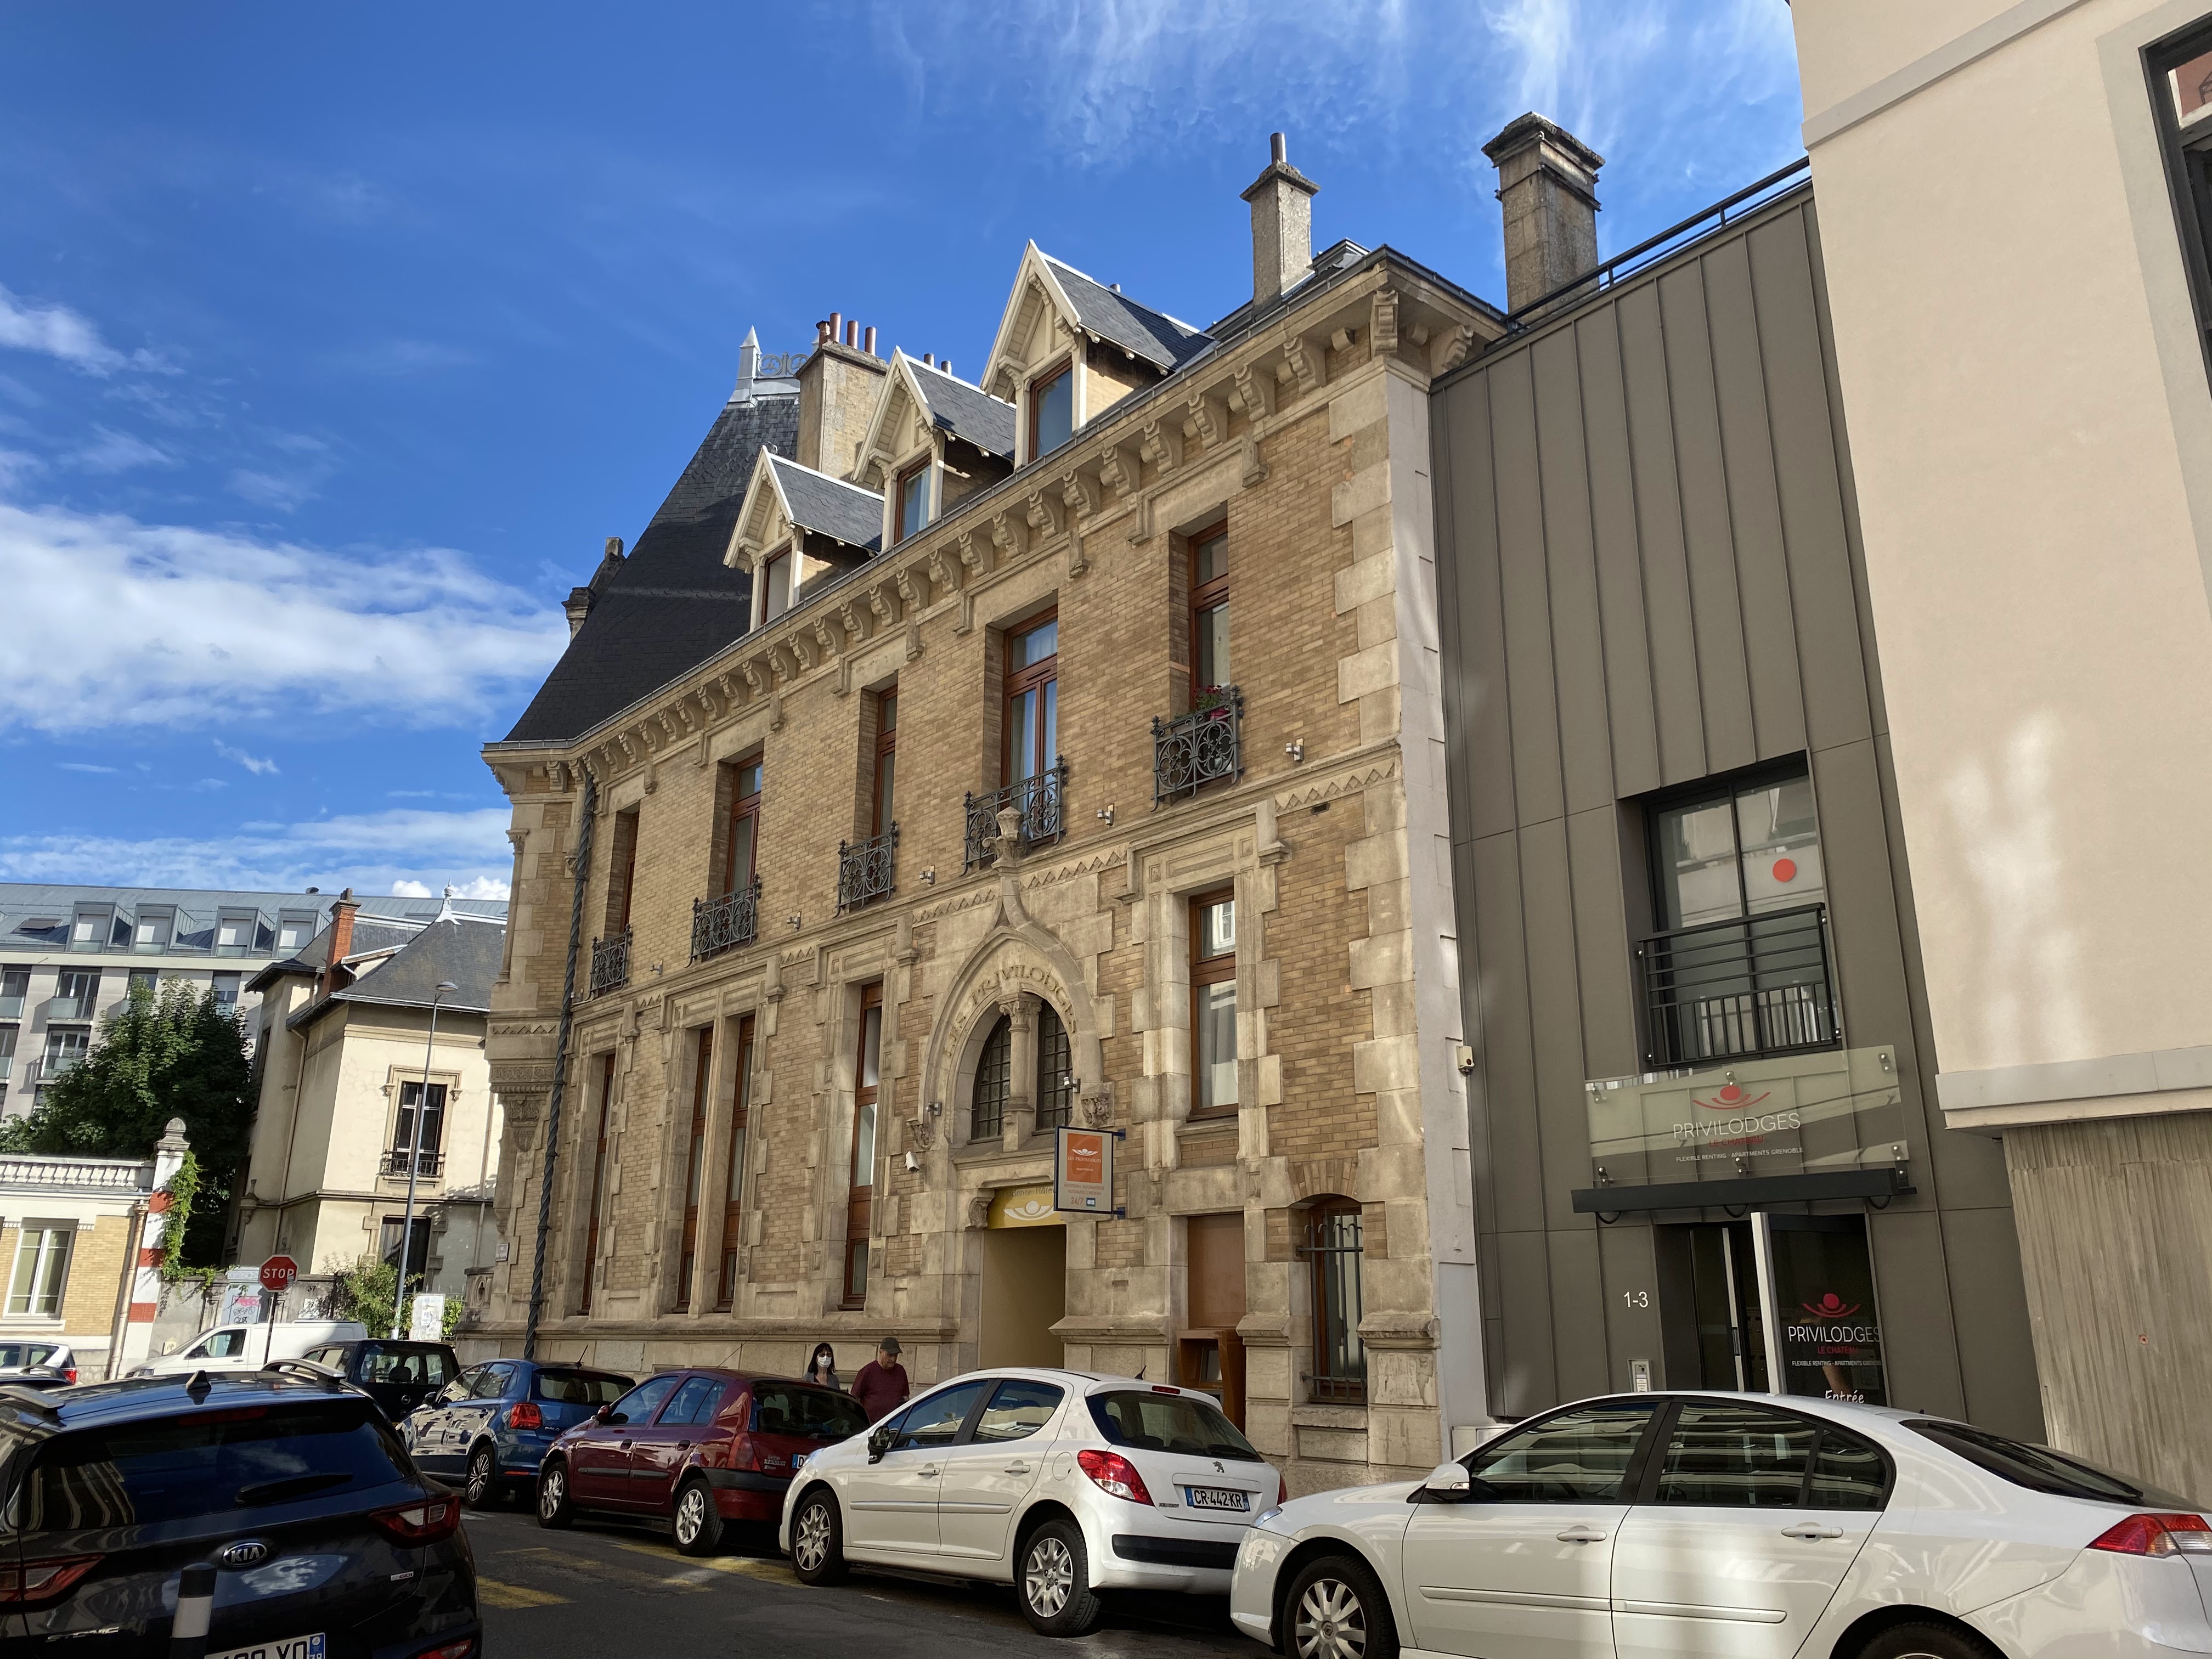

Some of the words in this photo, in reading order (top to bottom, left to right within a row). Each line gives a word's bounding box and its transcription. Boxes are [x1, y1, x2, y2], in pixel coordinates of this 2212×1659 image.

[1673, 1113, 1801, 1139] PRIVILODGES
[1709, 1139, 1719, 1148] LE
[1676, 1154, 1701, 1163] FLEXIBLE
[1731, 1149, 1770, 1158] APARTMENTS
[1771, 1147, 1803, 1155] GRENOBLE
[1071, 1197, 1084, 1205] 24/7
[263, 1268, 295, 1279] STOP
[1624, 1291, 1649, 1308] 1-3
[1788, 1326, 1880, 1342] PRIVILODGES
[1817, 1346, 1825, 1355] LE
[1825, 1389, 1864, 1403] Entrée
[231, 1547, 260, 1563] KIA
